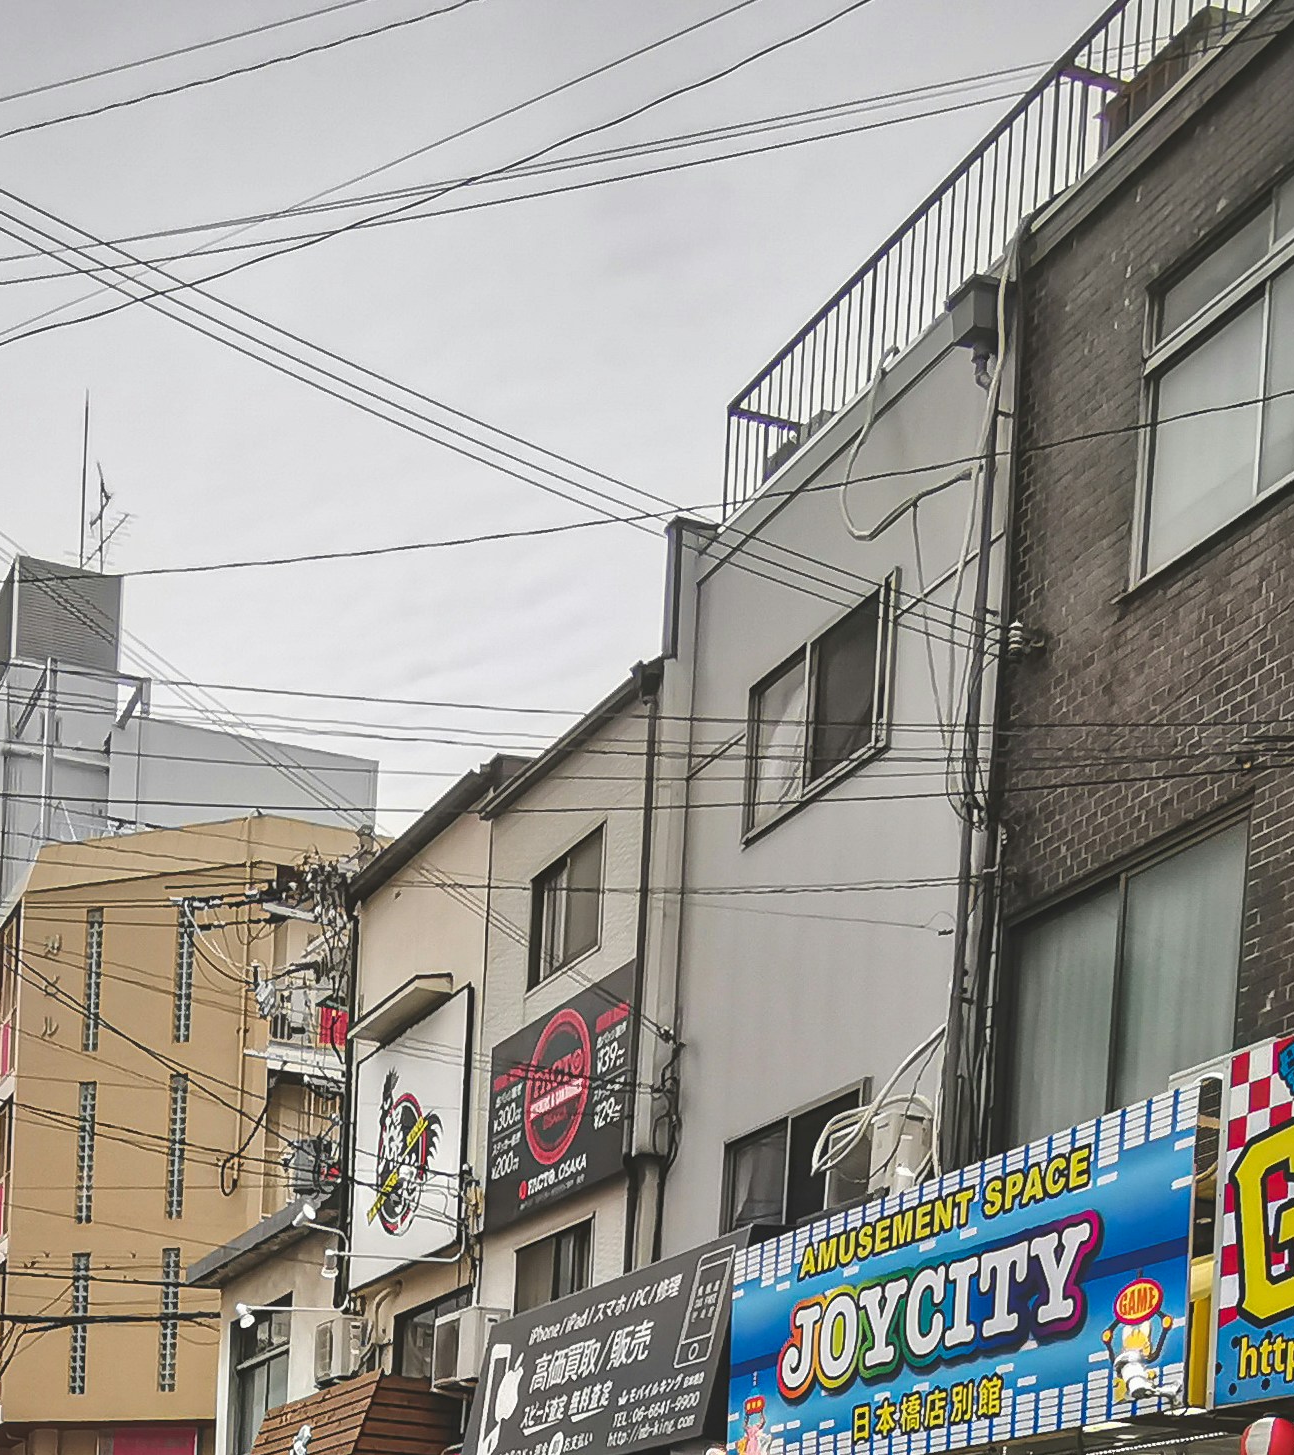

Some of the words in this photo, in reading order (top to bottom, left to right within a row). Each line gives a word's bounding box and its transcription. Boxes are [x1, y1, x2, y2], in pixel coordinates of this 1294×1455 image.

[798, 1191, 975, 1279] AMUSEMENT
[983, 1147, 1091, 1216] SPACE
[780, 1215, 1098, 1395] JOYCITY
[1117, 1285, 1159, 1321] GAME
[852, 1378, 1004, 1441] 日本橋店別館
